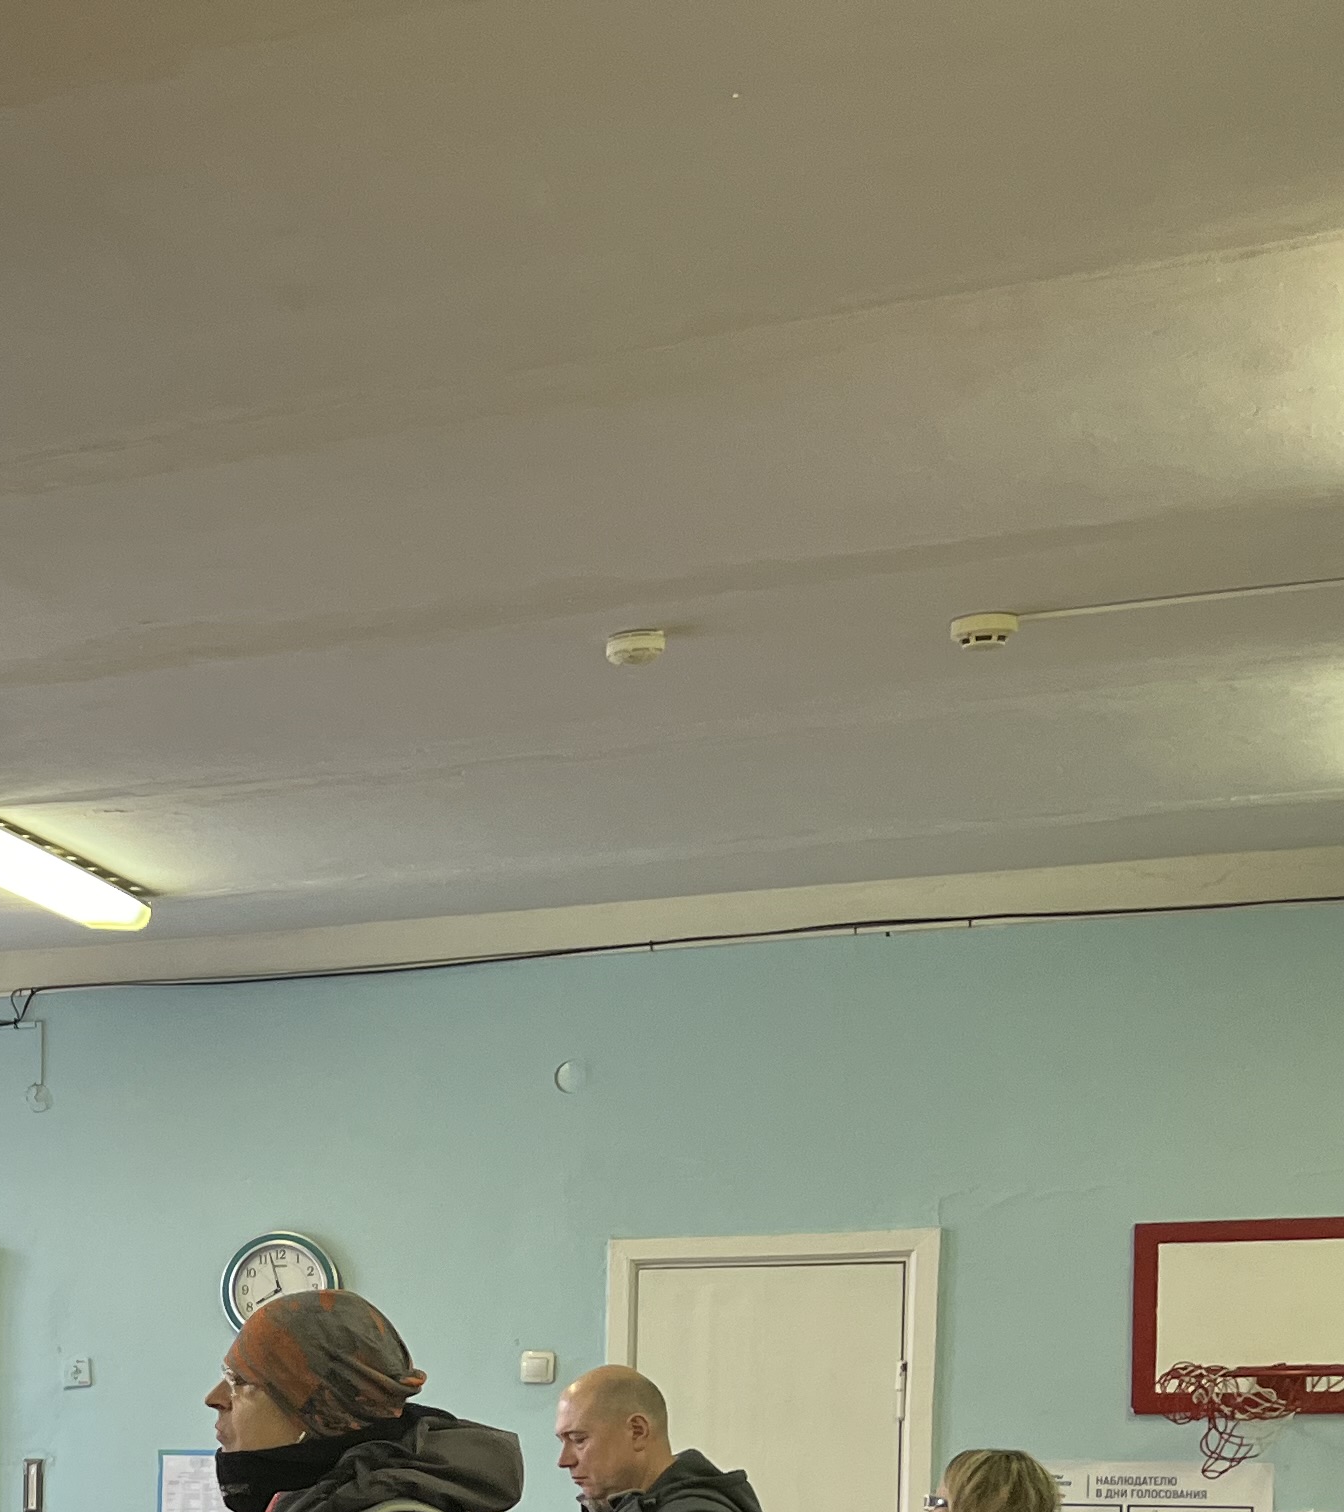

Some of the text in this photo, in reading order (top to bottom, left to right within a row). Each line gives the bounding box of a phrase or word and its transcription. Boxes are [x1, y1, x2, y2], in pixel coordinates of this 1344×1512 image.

[258, 1254, 268, 1265] 11
[275, 1249, 287, 1260] 12
[295, 1253, 300, 1264] 1
[246, 1267, 257, 1278] 10
[306, 1266, 315, 1277] 2
[241, 1284, 250, 1295] 9
[245, 1301, 254, 1313] 8
[1095, 1475, 1178, 1487] НАБЛЮДАТЕЛЮ
[1104, 1488, 1128, 1499] ДНИ
[1130, 1489, 1208, 1500] ГОЛОСОВАНИЯ
